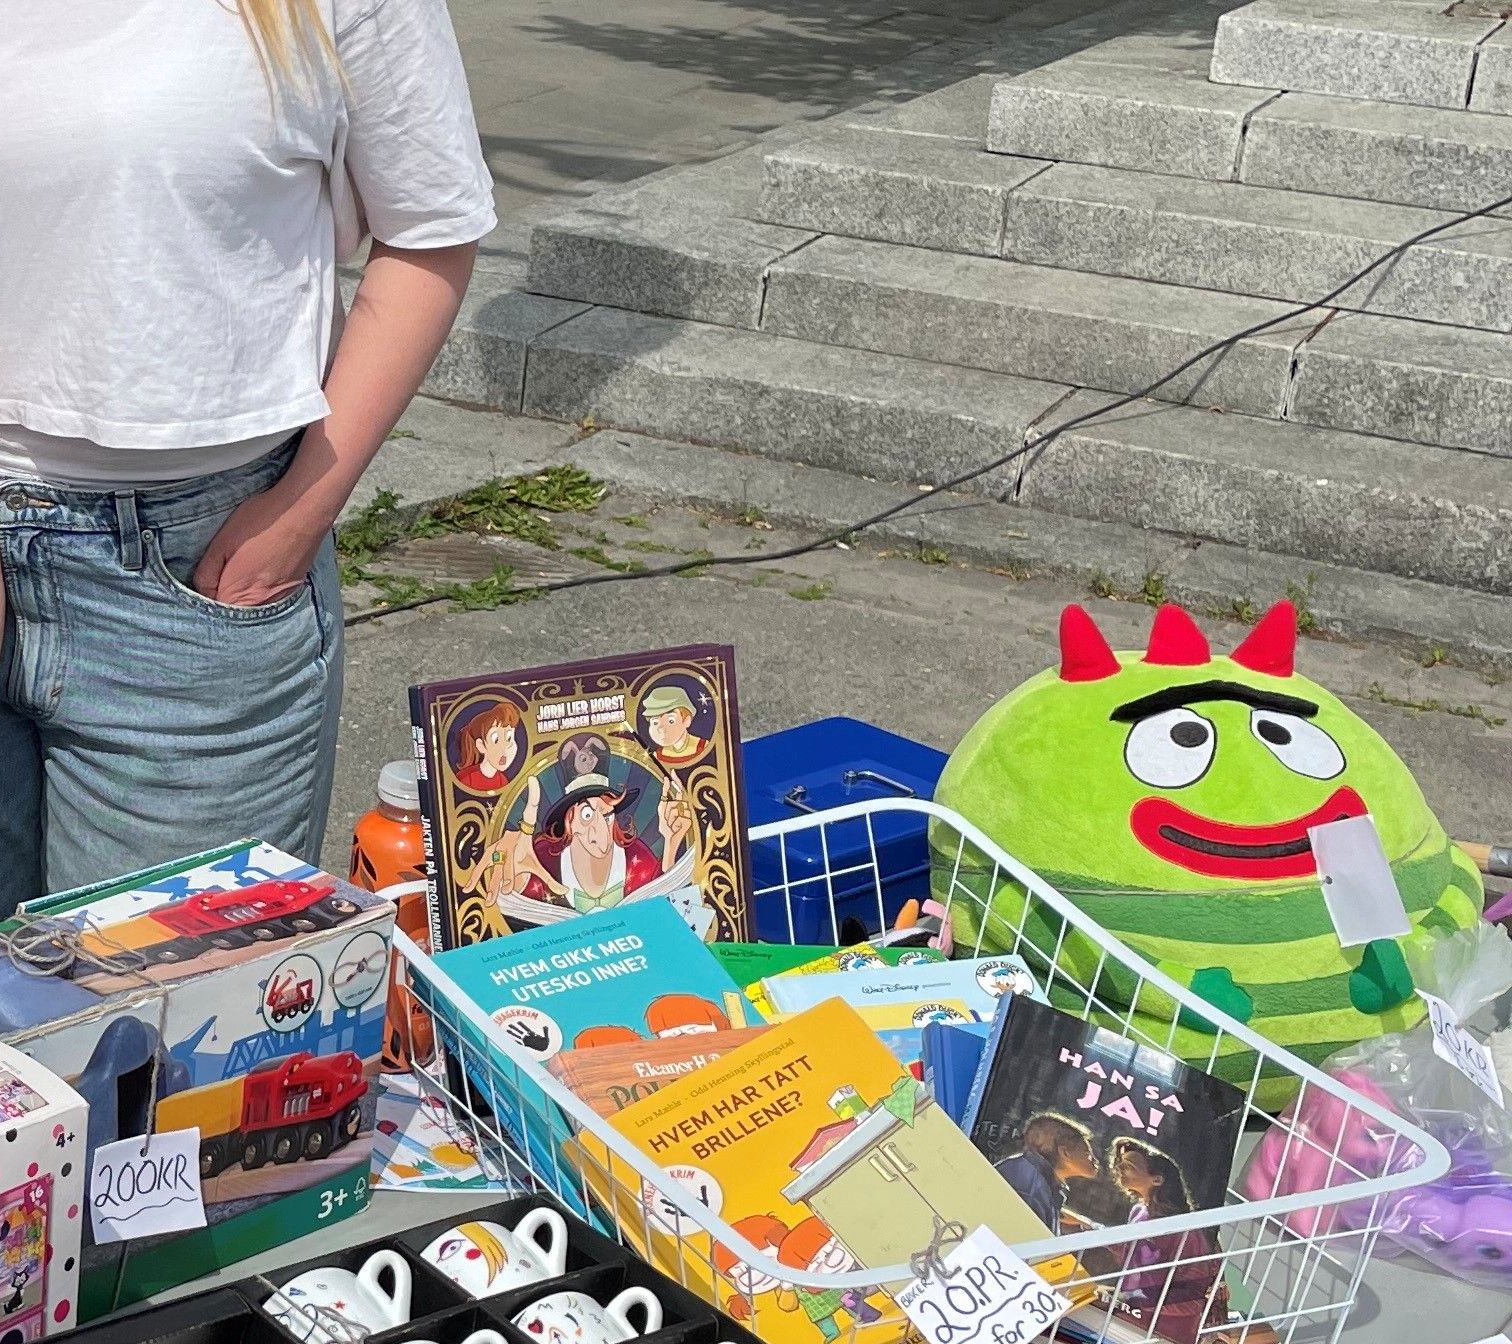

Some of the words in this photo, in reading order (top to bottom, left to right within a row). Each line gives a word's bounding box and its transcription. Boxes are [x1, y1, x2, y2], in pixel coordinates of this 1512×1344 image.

[421, 815, 434, 856] JAKTEN
[425, 861, 438, 877] PÅ
[490, 958, 551, 986] HVEM
[550, 947, 600, 969] GIKK
[598, 935, 644, 955] MED
[512, 971, 592, 1002] UTESKO
[591, 955, 649, 982] INNE?
[633, 1061, 688, 1078] Eleanor
[1059, 1047, 1134, 1090] HAN
[1144, 1086, 1185, 1113] SA
[648, 1110, 715, 1154] HVEM
[712, 1085, 763, 1119] HAR
[759, 1055, 814, 1092] TATT
[691, 1090, 804, 1161] BRILLENE?
[1076, 1080, 1165, 1137] JA!
[317, 1188, 348, 1219] 3+
